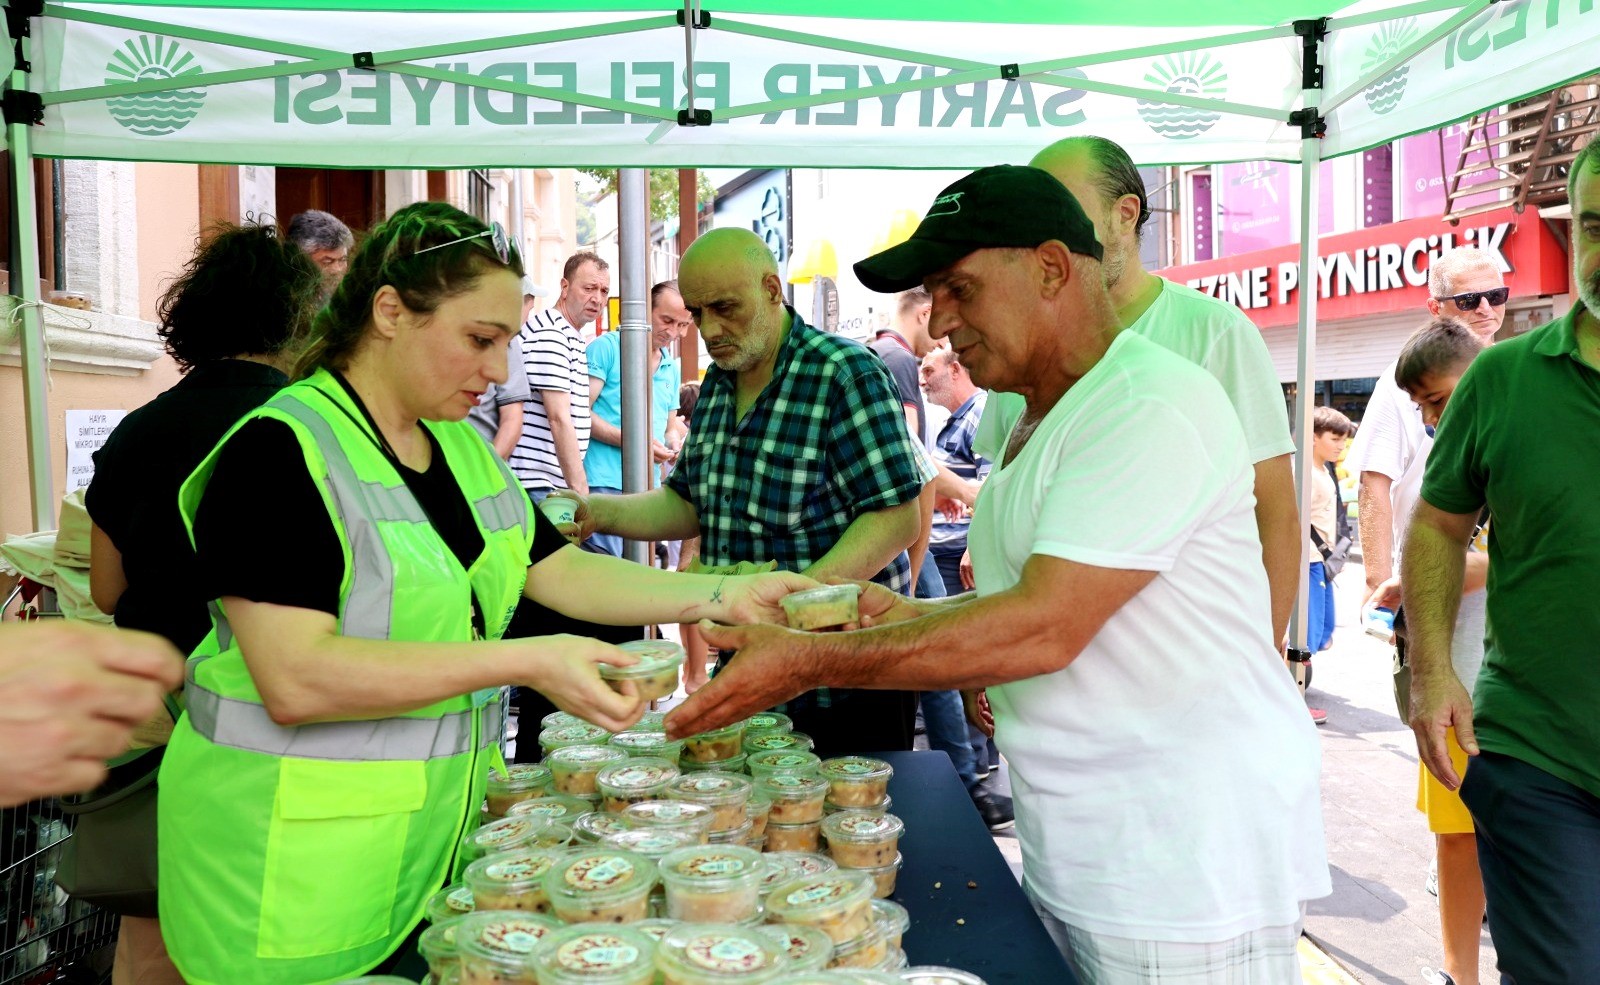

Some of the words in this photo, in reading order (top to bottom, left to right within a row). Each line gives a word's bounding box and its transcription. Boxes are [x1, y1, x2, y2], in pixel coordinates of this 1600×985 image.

[89, 414, 107, 424] HAYIR
[79, 425, 116, 437] SİMİTLERİMİ
[75, 439, 93, 449] MİKRO
